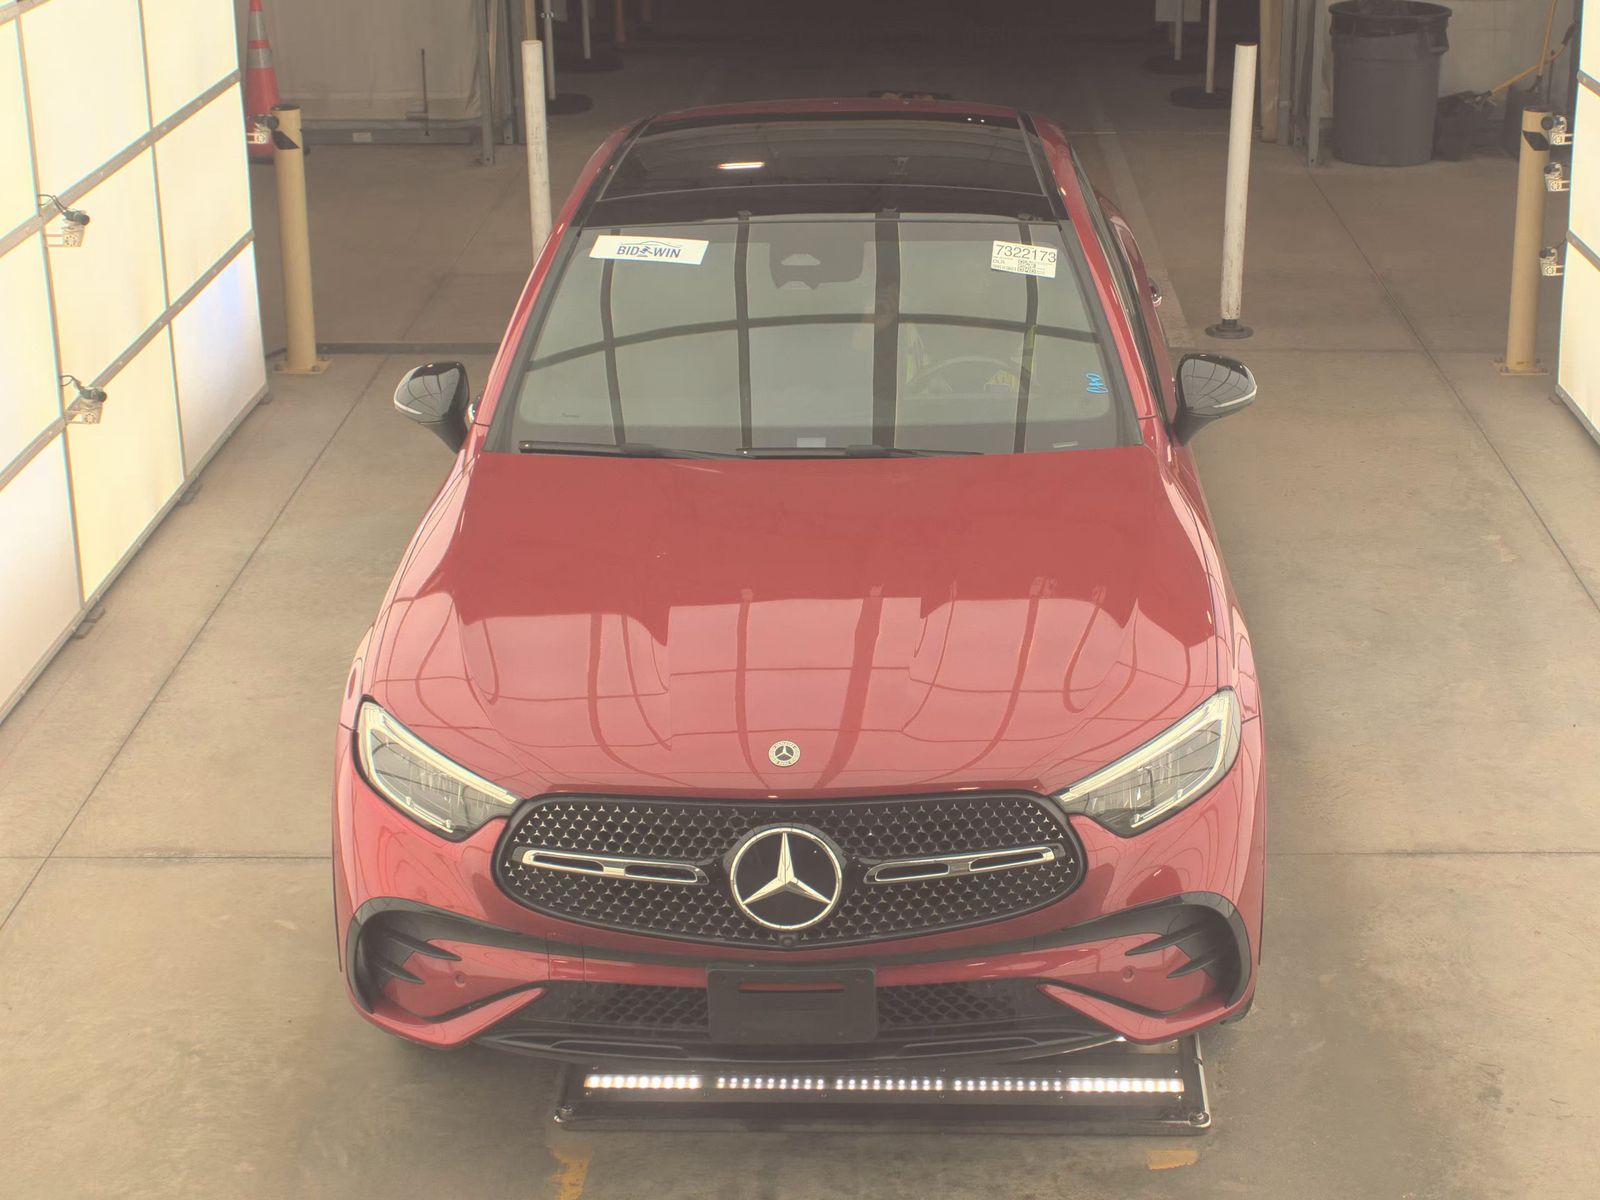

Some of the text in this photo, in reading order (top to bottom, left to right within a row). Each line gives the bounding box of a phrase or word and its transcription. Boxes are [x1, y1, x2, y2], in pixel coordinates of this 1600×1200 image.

[617, 245, 681, 258] BID WIN
[996, 244, 1057, 263] 7322173
